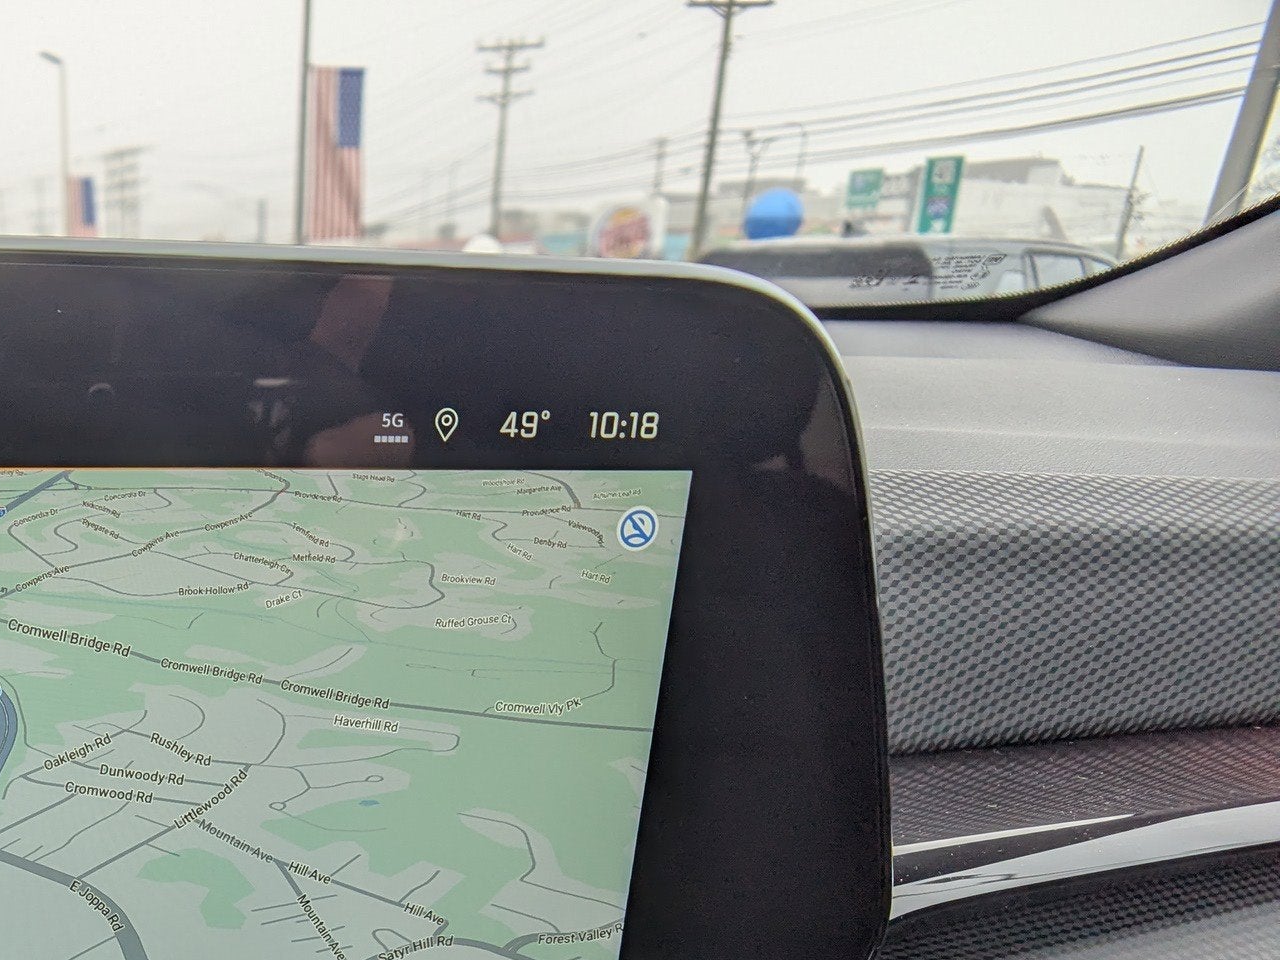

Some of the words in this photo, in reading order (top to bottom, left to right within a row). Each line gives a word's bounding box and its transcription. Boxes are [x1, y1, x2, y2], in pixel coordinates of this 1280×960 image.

[381, 412, 404, 428] 5G
[498, 409, 551, 439] 49°
[588, 410, 660, 440] 10:18
[103, 492, 137, 502] Concordia
[138, 490, 147, 498] Dr
[294, 490, 332, 502] Providence
[332, 494, 343, 503] Rd
[13, 510, 48, 527] Concordia
[49, 507, 59, 517] Dr
[111, 509, 121, 519] Rd
[455, 509, 471, 519] Hart
[471, 512, 482, 521] Rd
[521, 507, 561, 517] Providence
[561, 504, 571, 513] Rd
[81, 518, 110, 535] Ryegate
[110, 530, 120, 540] Rd
[204, 516, 237, 533] Cowpens
[237, 511, 253, 523] Ave
[567, 519, 601, 539] Valewood
[131, 536, 166, 558] Cowpens
[165, 529, 180, 542] Ave
[319, 538, 330, 549] Rd
[506, 543, 520, 557] Hart
[520, 550, 533, 562] Rd
[533, 536, 555, 549] Denby
[556, 540, 567, 550] Rd
[233, 551, 280, 570] Chatterleigh
[325, 555, 336, 564] Rd
[14, 570, 53, 592] Cowpens
[53, 564, 70, 577] Ave
[440, 573, 484, 586] Brookview
[485, 576, 496, 586] Rd
[581, 569, 598, 582] Hart
[599, 573, 611, 584] Rd
[178, 586, 204, 596] Brook
[205, 585, 235, 596] Hollow
[238, 582, 249, 592] Rd
[265, 594, 291, 610] Drake
[291, 590, 303, 601] Ct
[434, 617, 466, 628] Ruffed
[467, 616, 499, 627] Grouse
[500, 613, 512, 625] Ct
[7, 617, 68, 643] Cromwell
[69, 632, 110, 655] Bridge
[111, 642, 131, 658] Rd
[160, 657, 211, 676] Cromwell
[212, 666, 246, 683] Bridge
[247, 672, 263, 685] Rd
[280, 679, 334, 700] Cromwell
[335, 690, 372, 709] Bridge
[373, 697, 390, 710] Rd
[494, 700, 546, 716] Cromwell
[548, 701, 564, 717] Vly
[565, 697, 582, 711] Pk
[333, 714, 381, 731] Haverhill
[383, 720, 399, 732] Rd
[43, 742, 94, 772] Oakleigh
[95, 733, 112, 749] Rd
[150, 732, 193, 763] Rushley
[194, 751, 212, 767] Rd
[99, 763, 166, 784] Dunwoody
[167, 771, 185, 786] Rd
[64, 781, 135, 802] Cromwood
[136, 789, 153, 804] Rd
[173, 783, 233, 830] Littlewood
[231, 769, 248, 787] Rd
[198, 818, 249, 852] Mountain
[249, 845, 274, 864] Ave
[287, 861, 308, 878] Hill
[308, 869, 331, 885] Ave
[69, 880, 81, 892] E
[78, 887, 111, 918] Joppa
[106, 913, 124, 932] Rd
[403, 901, 424, 918] Hill
[423, 909, 445, 926] Ave
[296, 894, 329, 943] Mountain
[327, 937, 345, 960] Ave
[537, 933, 576, 945] Forest
[578, 928, 613, 942] Valley
[614, 922, 624, 933] R
[412, 938, 435, 952] Hill
[436, 934, 454, 948] Rd
